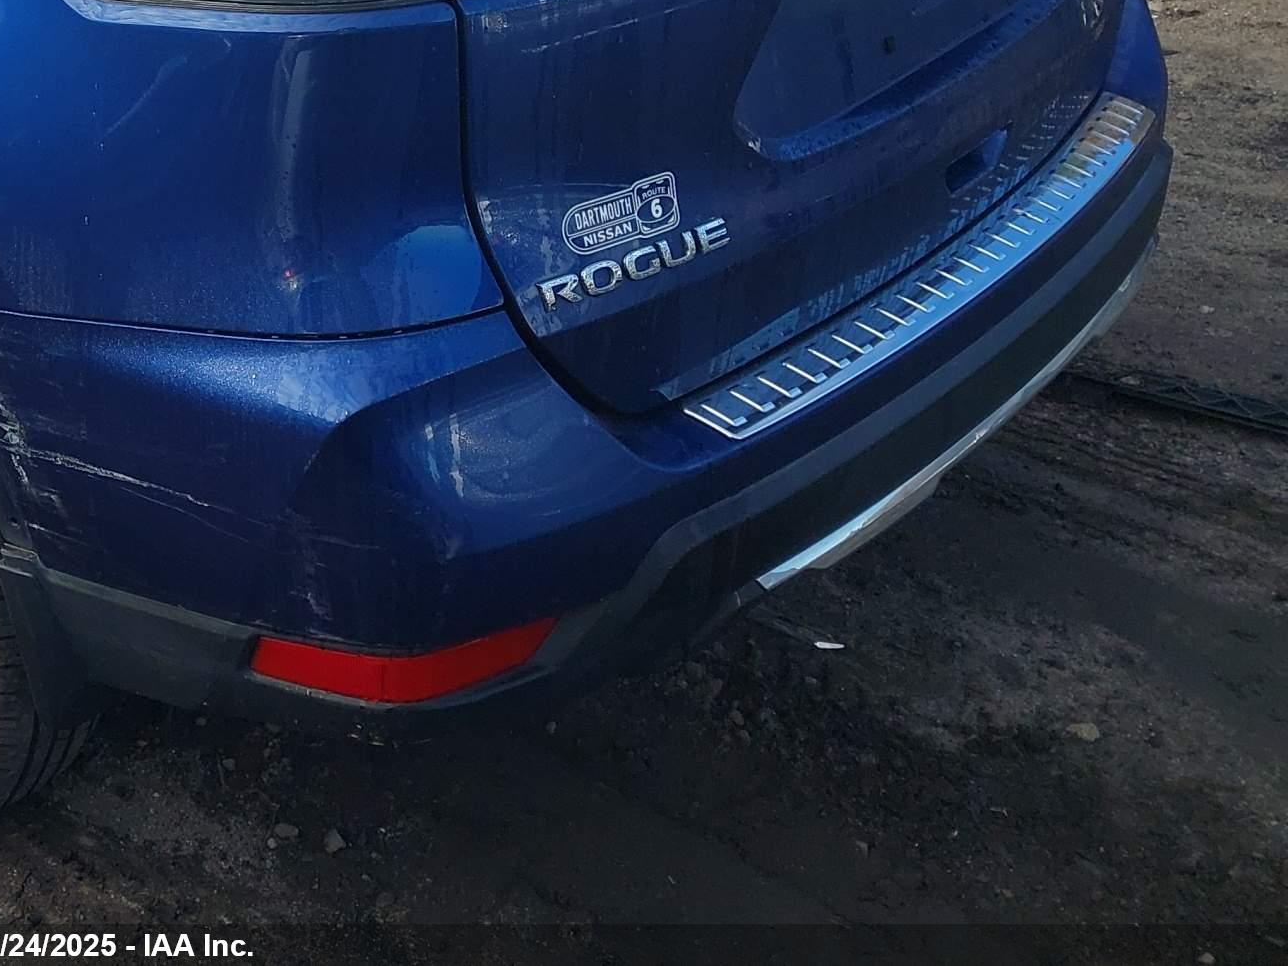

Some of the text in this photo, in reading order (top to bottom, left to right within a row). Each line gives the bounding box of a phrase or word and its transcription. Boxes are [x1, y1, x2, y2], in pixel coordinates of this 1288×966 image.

[642, 186, 666, 200] ROUTE
[574, 196, 633, 230] DARTMOUTH
[651, 198, 663, 218] 6
[583, 221, 633, 247] NISSAN
[536, 217, 731, 312] ROGUE
